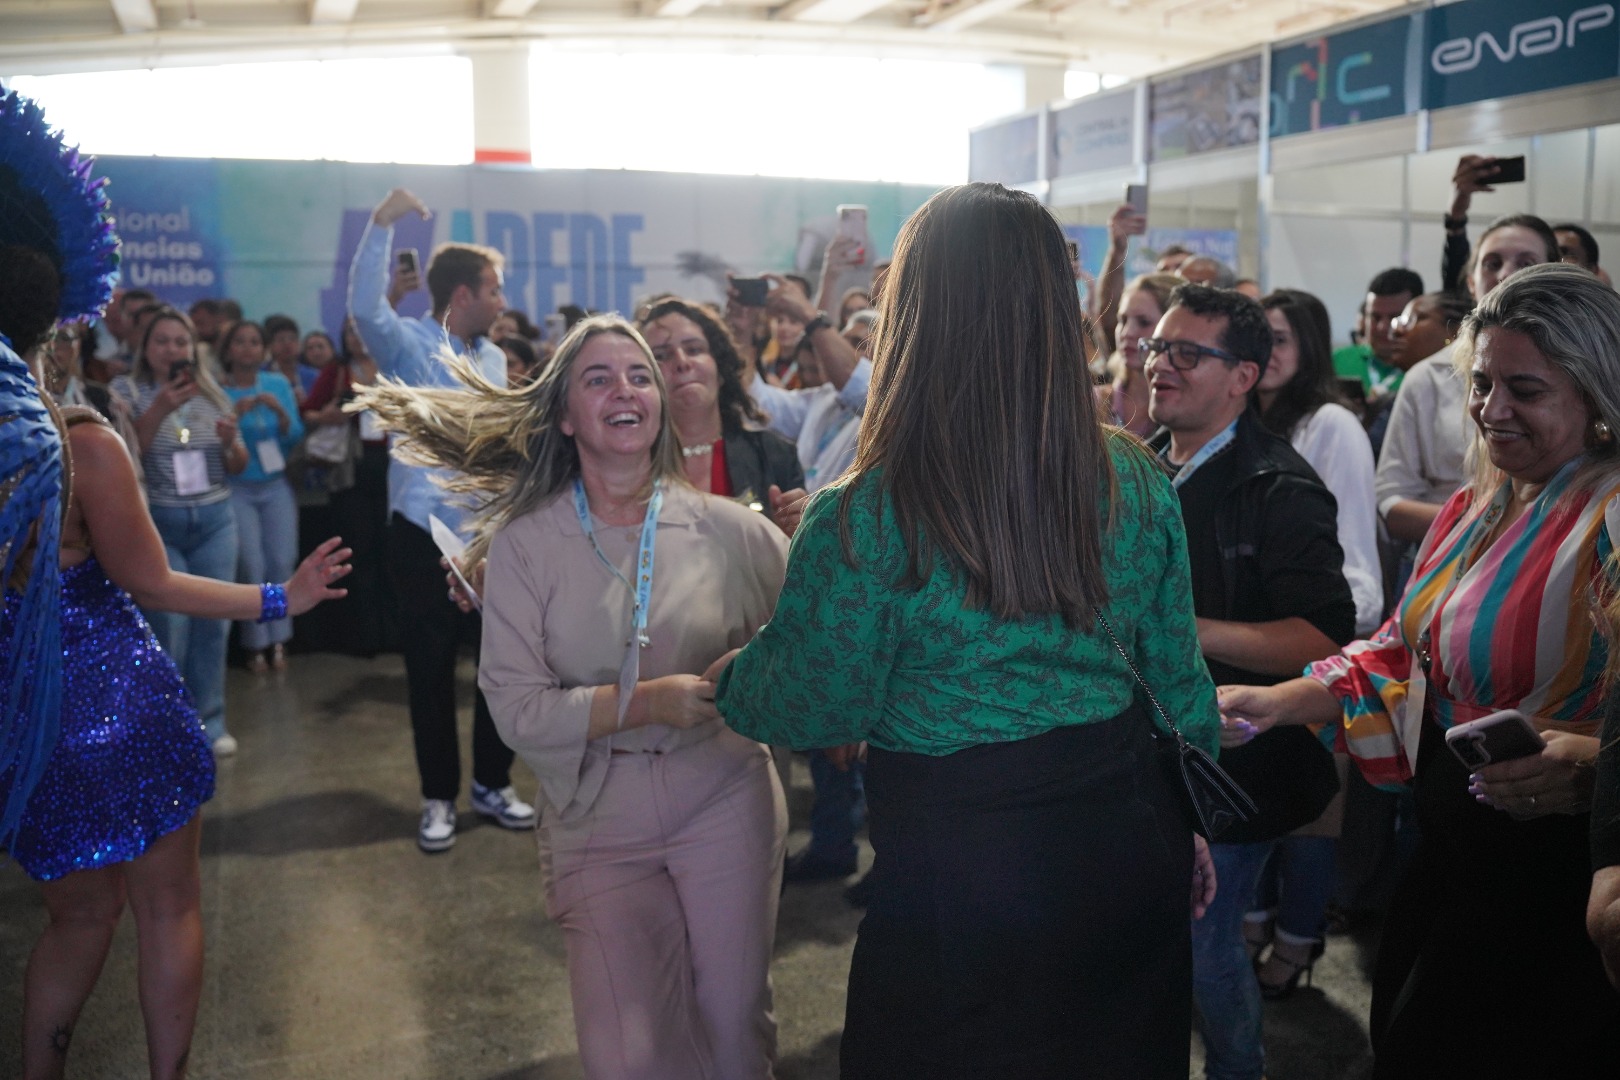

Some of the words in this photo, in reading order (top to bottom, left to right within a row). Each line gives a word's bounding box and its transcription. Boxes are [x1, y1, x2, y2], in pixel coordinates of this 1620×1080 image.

[116, 206, 190, 233] ional
[122, 237, 203, 260] ncias
[129, 263, 214, 287] União
